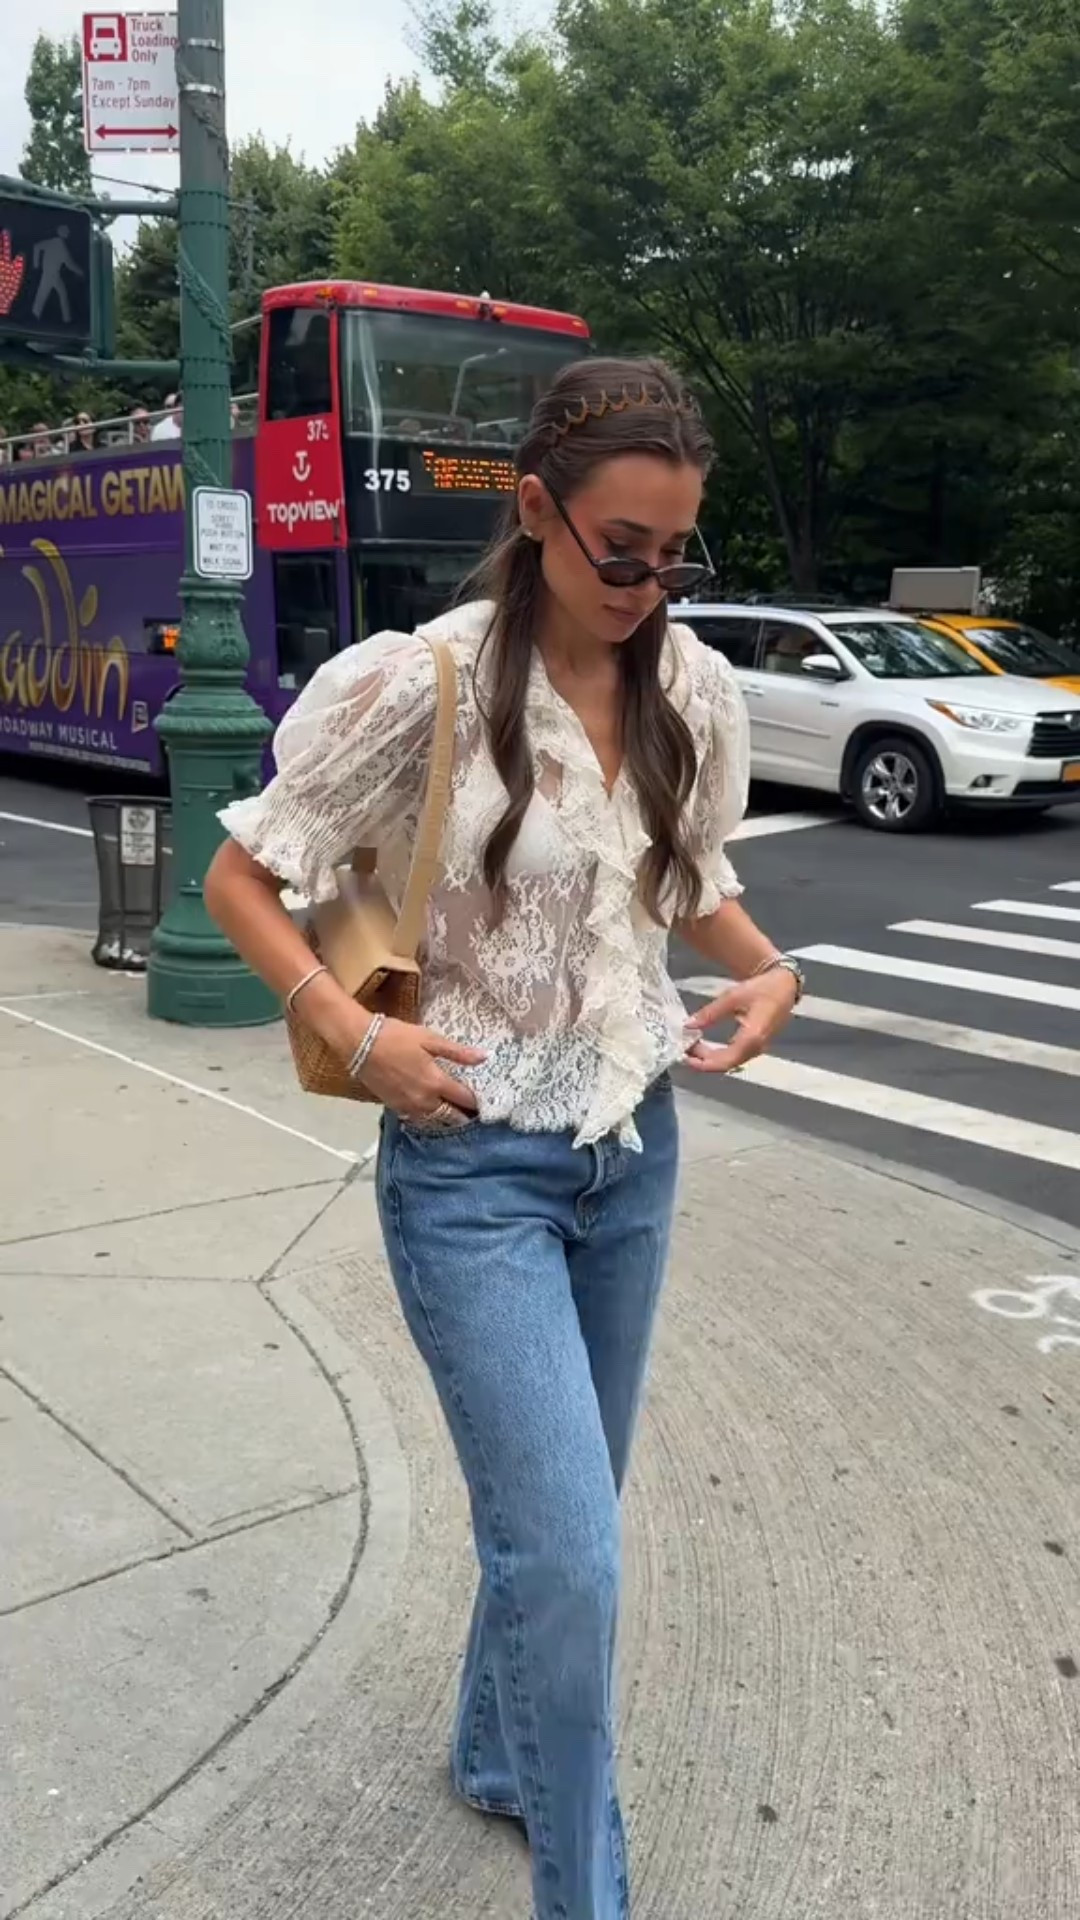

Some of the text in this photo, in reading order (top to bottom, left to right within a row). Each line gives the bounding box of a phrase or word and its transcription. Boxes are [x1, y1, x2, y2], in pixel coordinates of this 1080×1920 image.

[131, 18, 164, 31] Truck
[131, 34, 179, 49] Loading
[131, 50, 159, 64] Only
[92, 78, 115, 91] 7am
[128, 77, 151, 93] 7pm
[92, 95, 176, 111] Except Sunday
[364, 468, 411, 492] 375
[0, 474, 98, 525] MAGICAL
[0, 537, 130, 721] addin
[58, 725, 118, 750] MUSICAL
